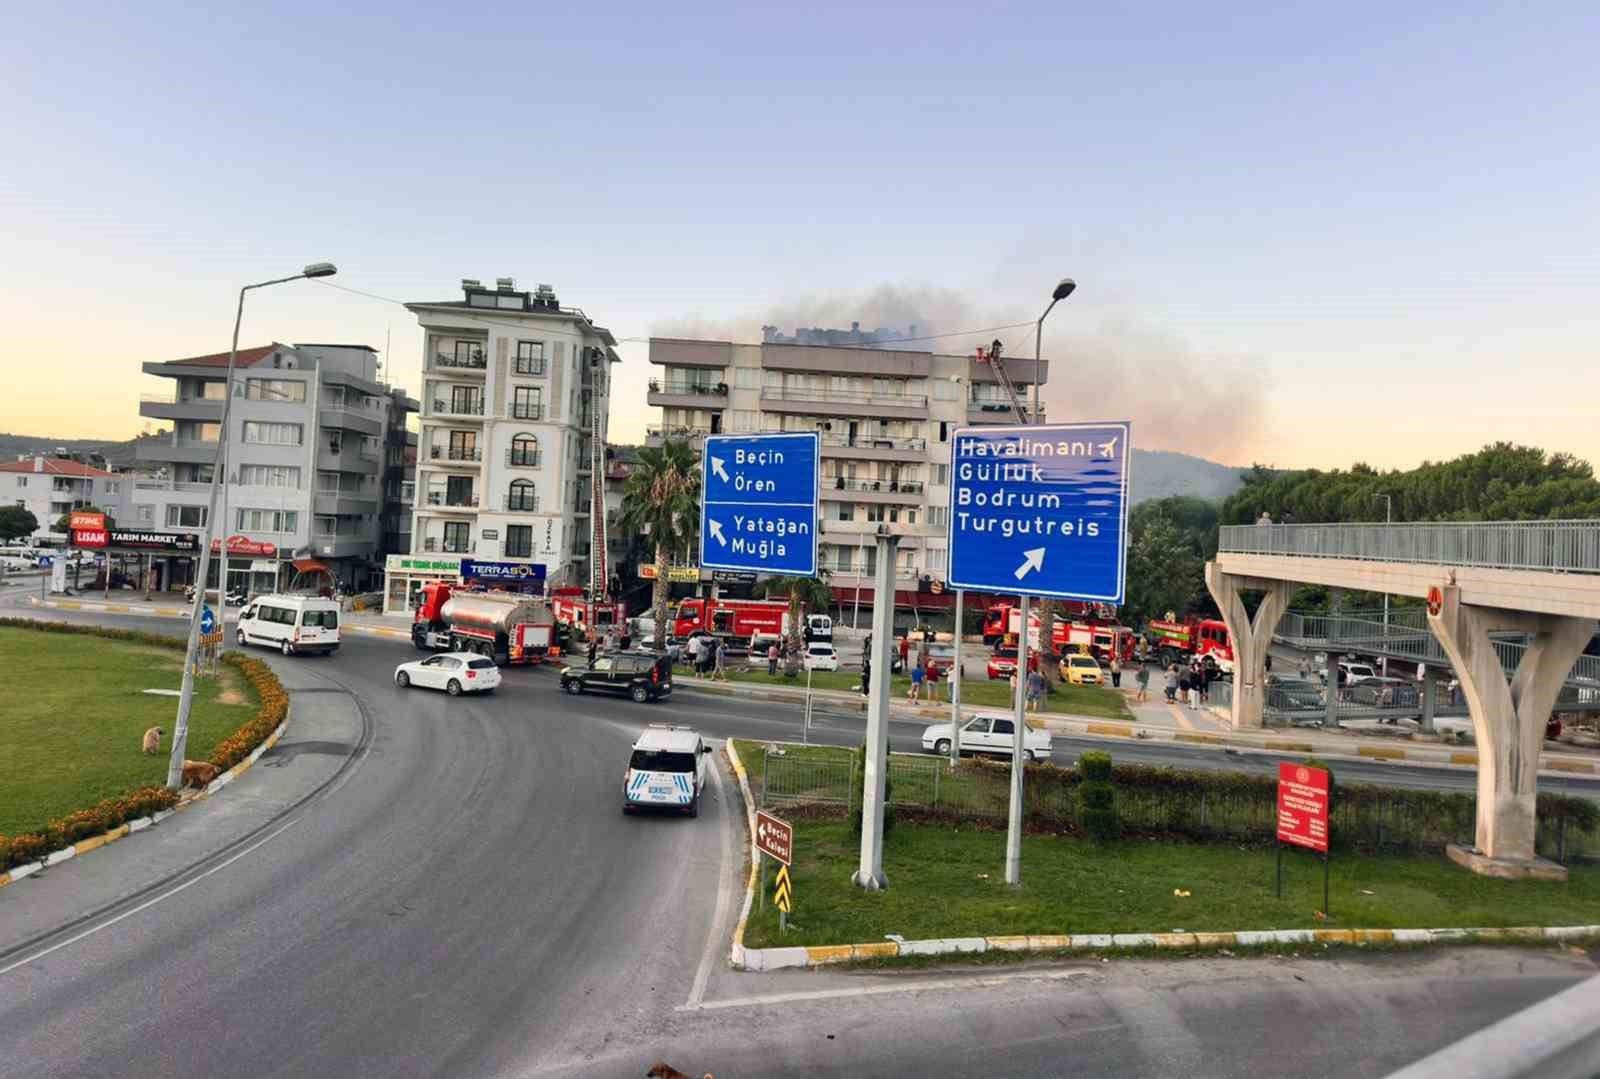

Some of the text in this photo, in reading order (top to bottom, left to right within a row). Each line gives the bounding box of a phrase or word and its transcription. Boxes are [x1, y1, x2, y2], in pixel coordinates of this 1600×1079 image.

[735, 449, 784, 466] Beçin
[960, 438, 1092, 457] Havalimanı
[734, 471, 776, 492] Ören
[959, 462, 1043, 482] Güllük
[958, 487, 1061, 509] Bodrum
[734, 515, 809, 537] Yatağan
[958, 512, 1100, 537] Turgutreis
[141, 533, 178, 544] MARKET
[731, 538, 786, 559] Muğla
[470, 563, 536, 578] TERRASOL
